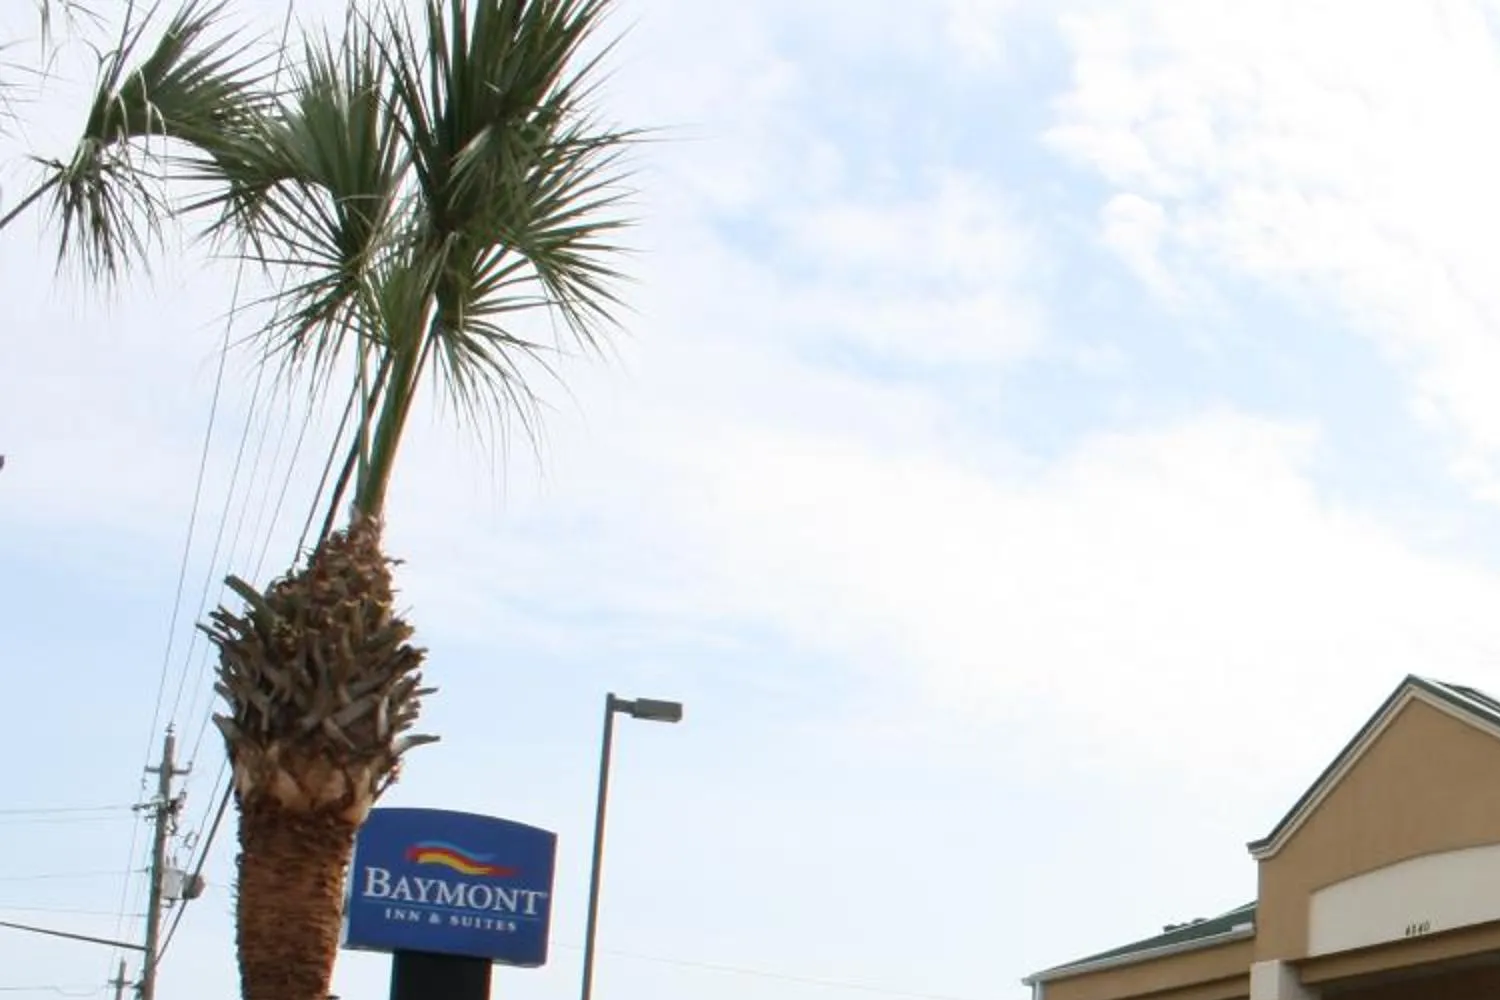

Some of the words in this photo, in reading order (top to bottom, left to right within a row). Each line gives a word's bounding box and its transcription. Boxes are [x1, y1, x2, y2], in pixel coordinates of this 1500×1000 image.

[363, 867, 542, 915] BAYMONT
[385, 908, 422, 922] INN
[429, 912, 442, 925] &
[450, 915, 516, 931] SUITES
